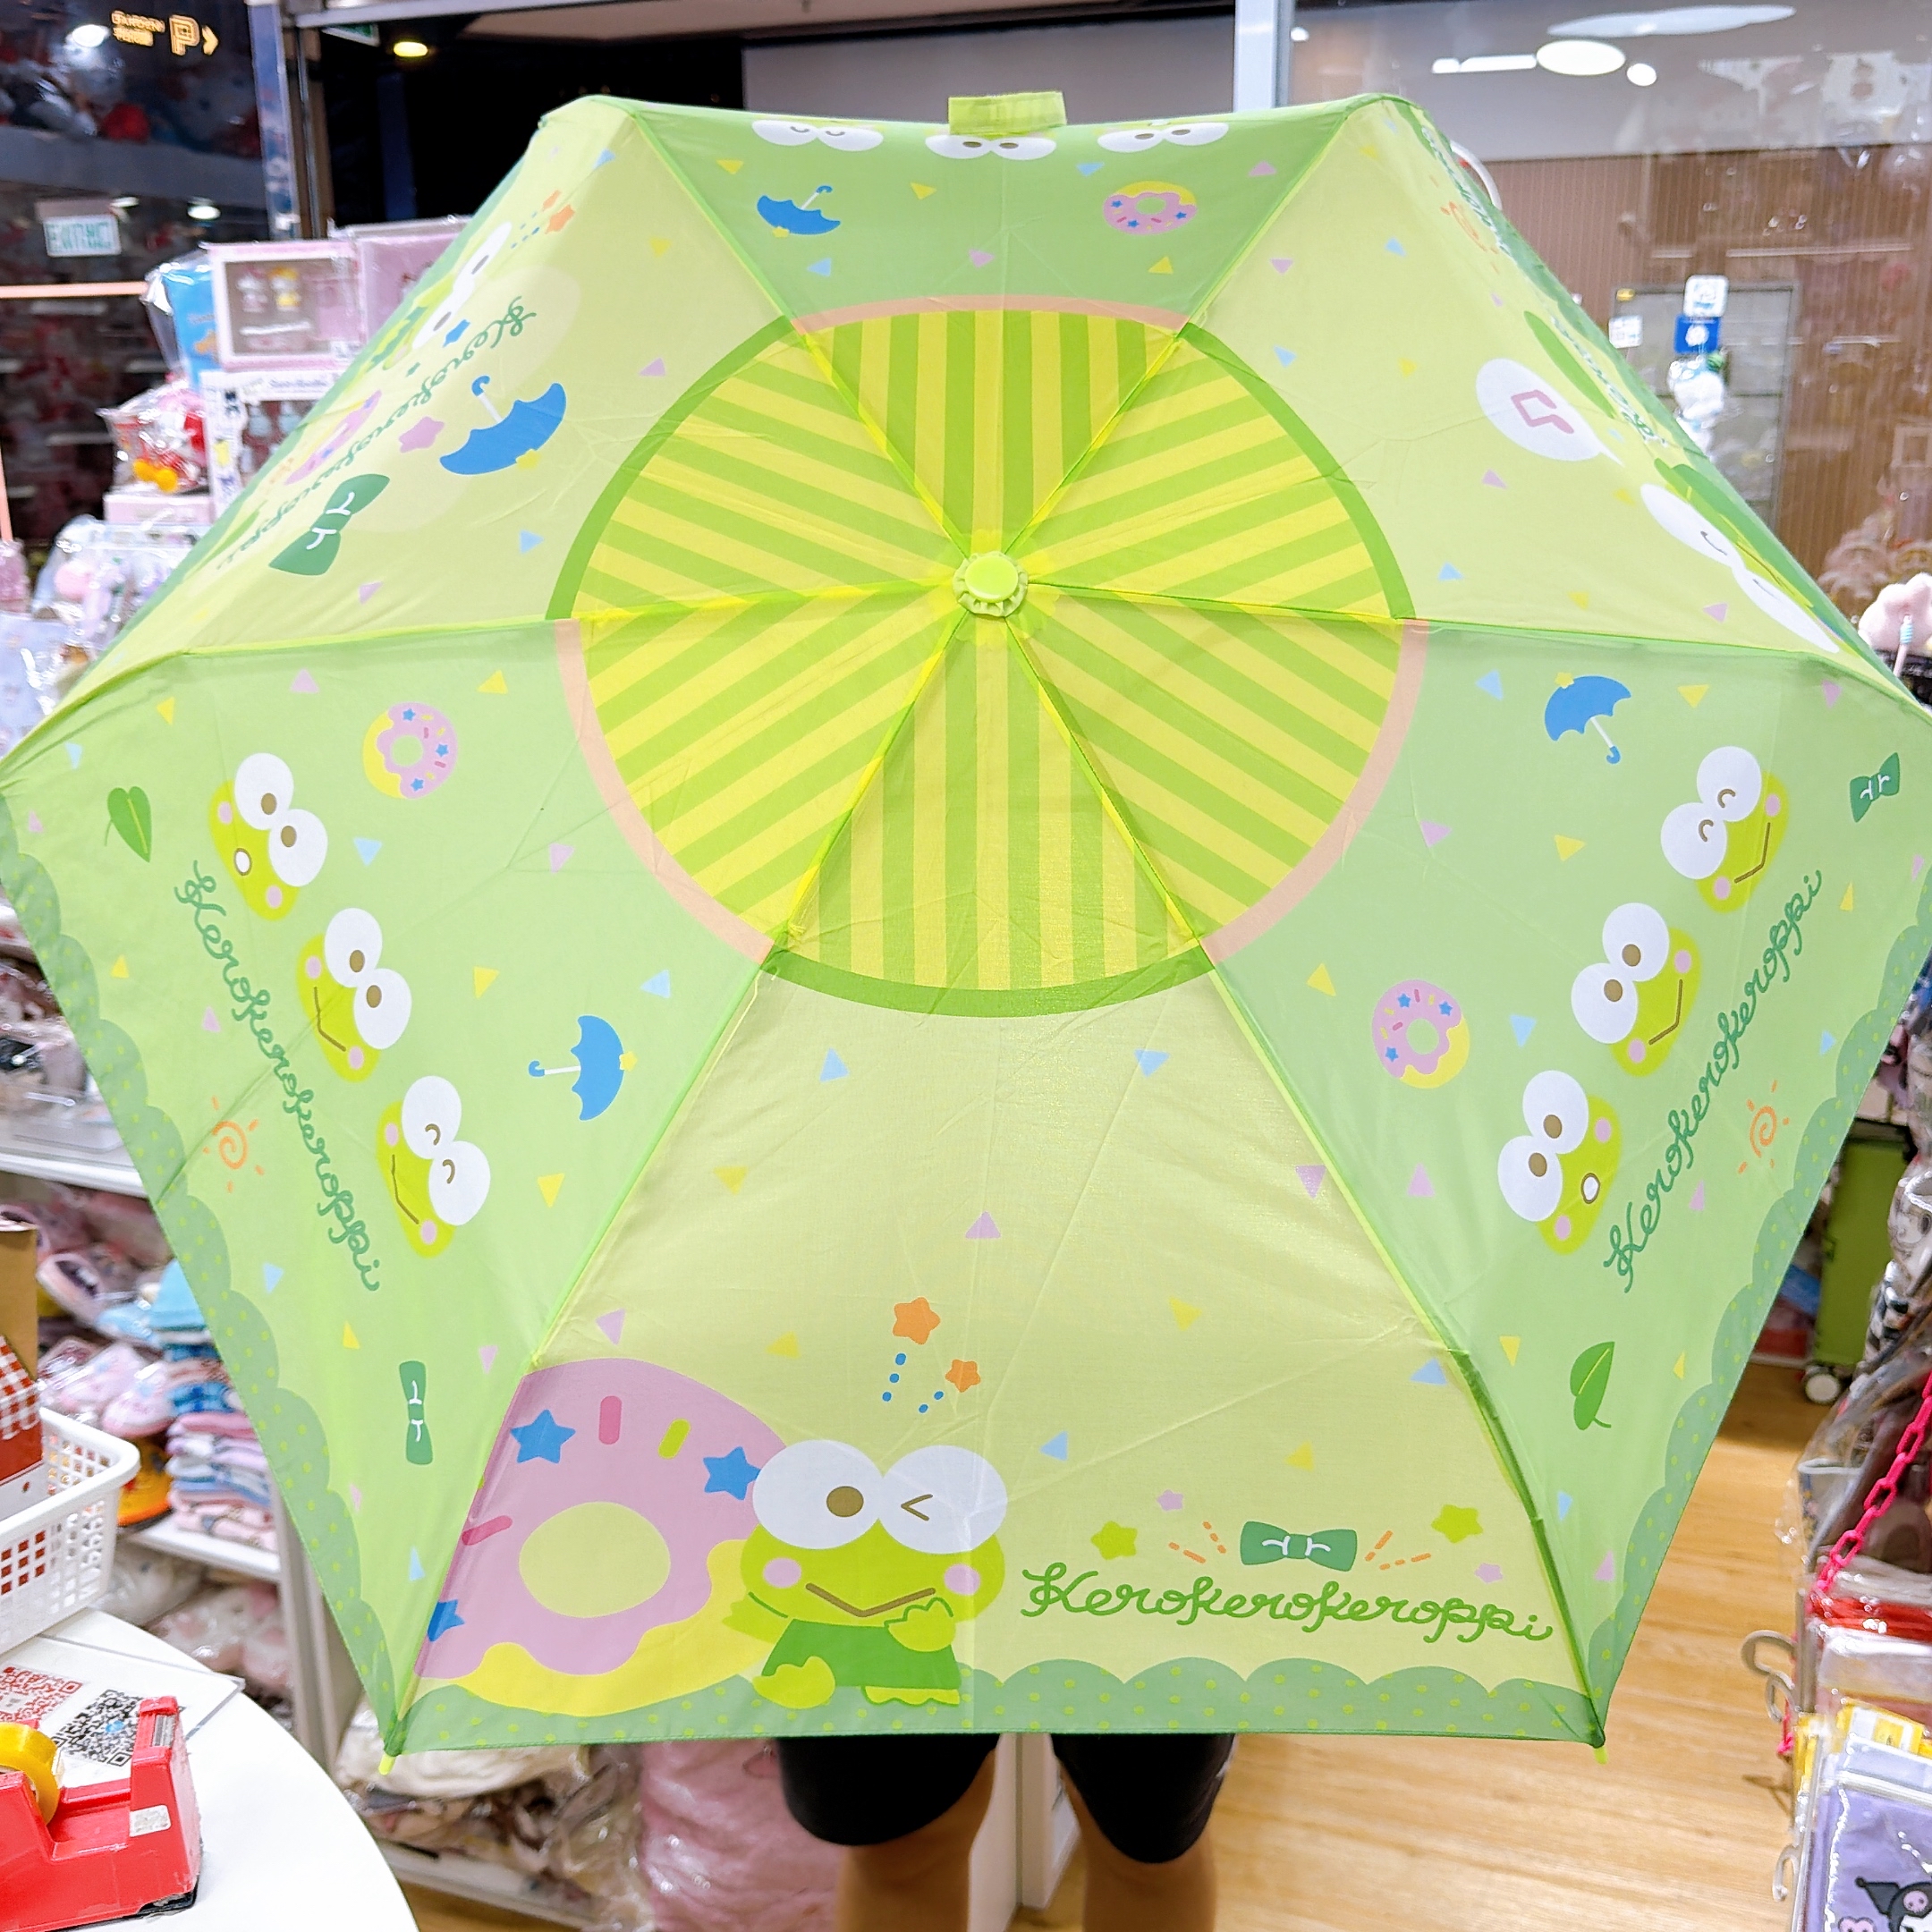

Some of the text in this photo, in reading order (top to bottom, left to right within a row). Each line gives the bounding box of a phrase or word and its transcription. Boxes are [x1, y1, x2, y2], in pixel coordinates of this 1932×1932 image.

[175, 860, 380, 1291] Kerokerokeroppi
[1603, 869, 1823, 1293] Kerokerokeroppi
[1021, 1562, 1554, 1644] Kerokerokeroppi
